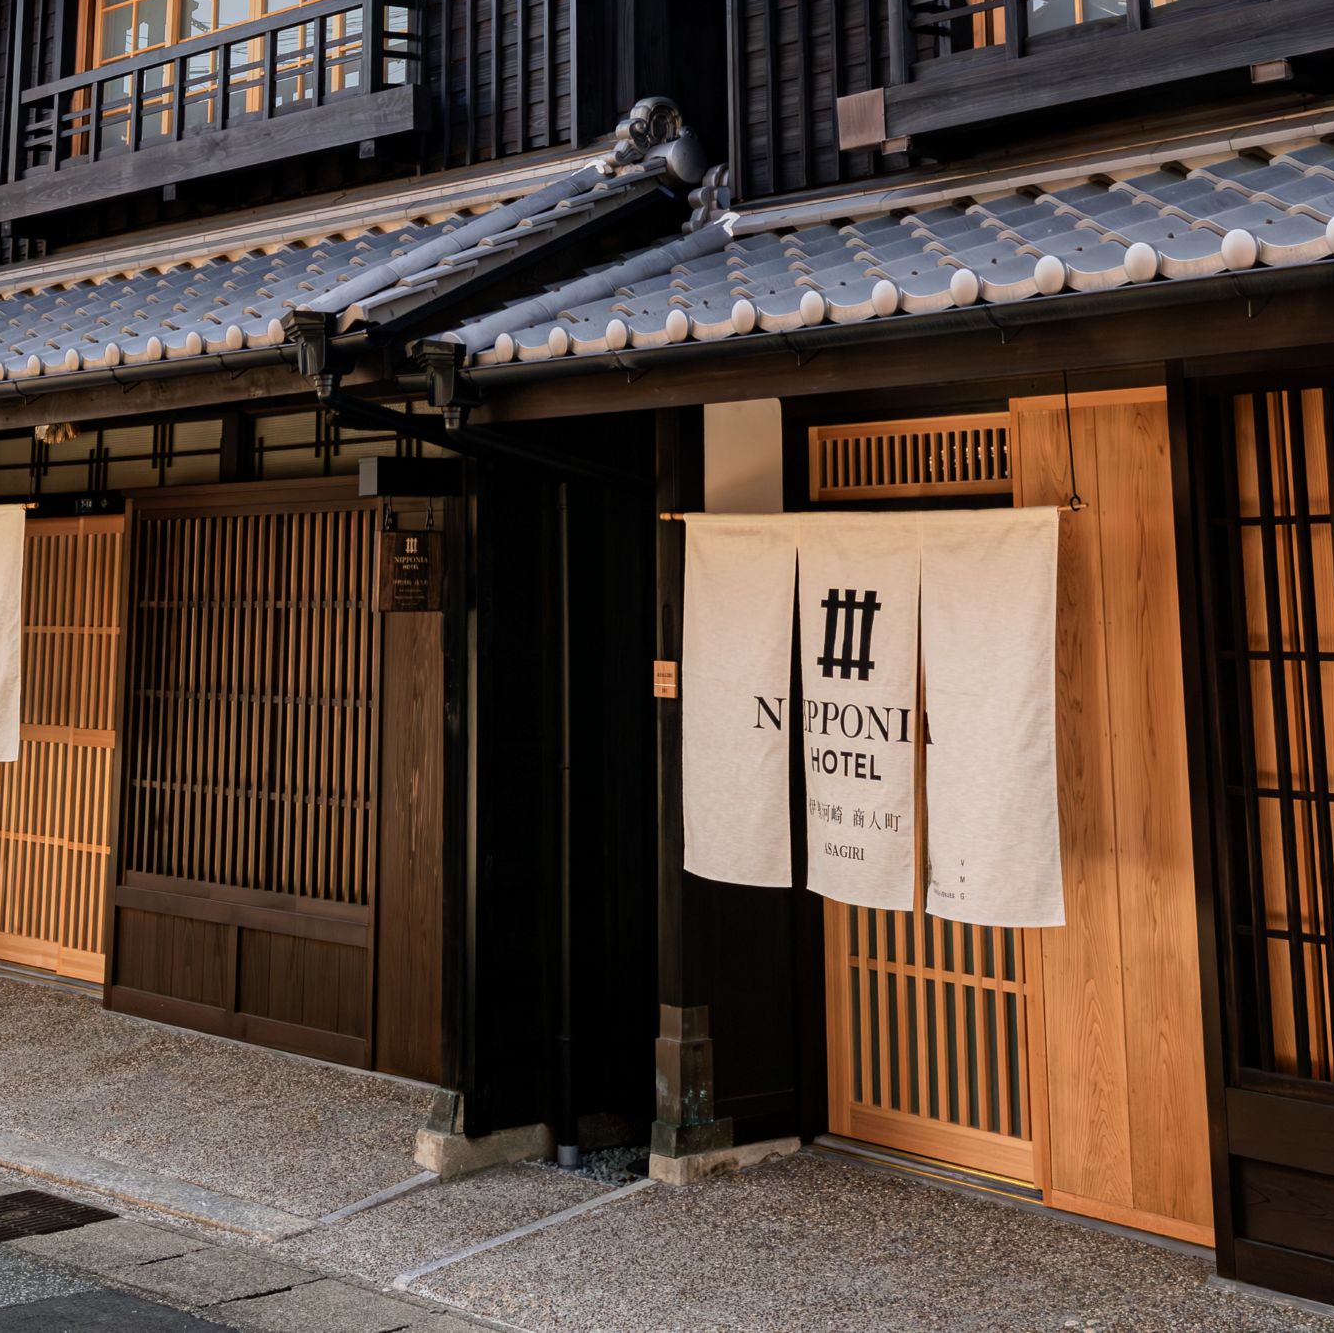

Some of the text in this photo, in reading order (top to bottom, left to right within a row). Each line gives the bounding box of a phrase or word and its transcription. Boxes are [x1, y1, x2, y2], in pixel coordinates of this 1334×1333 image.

[811, 747, 881, 781] HOTEL
[853, 808, 901, 832] 商人町
